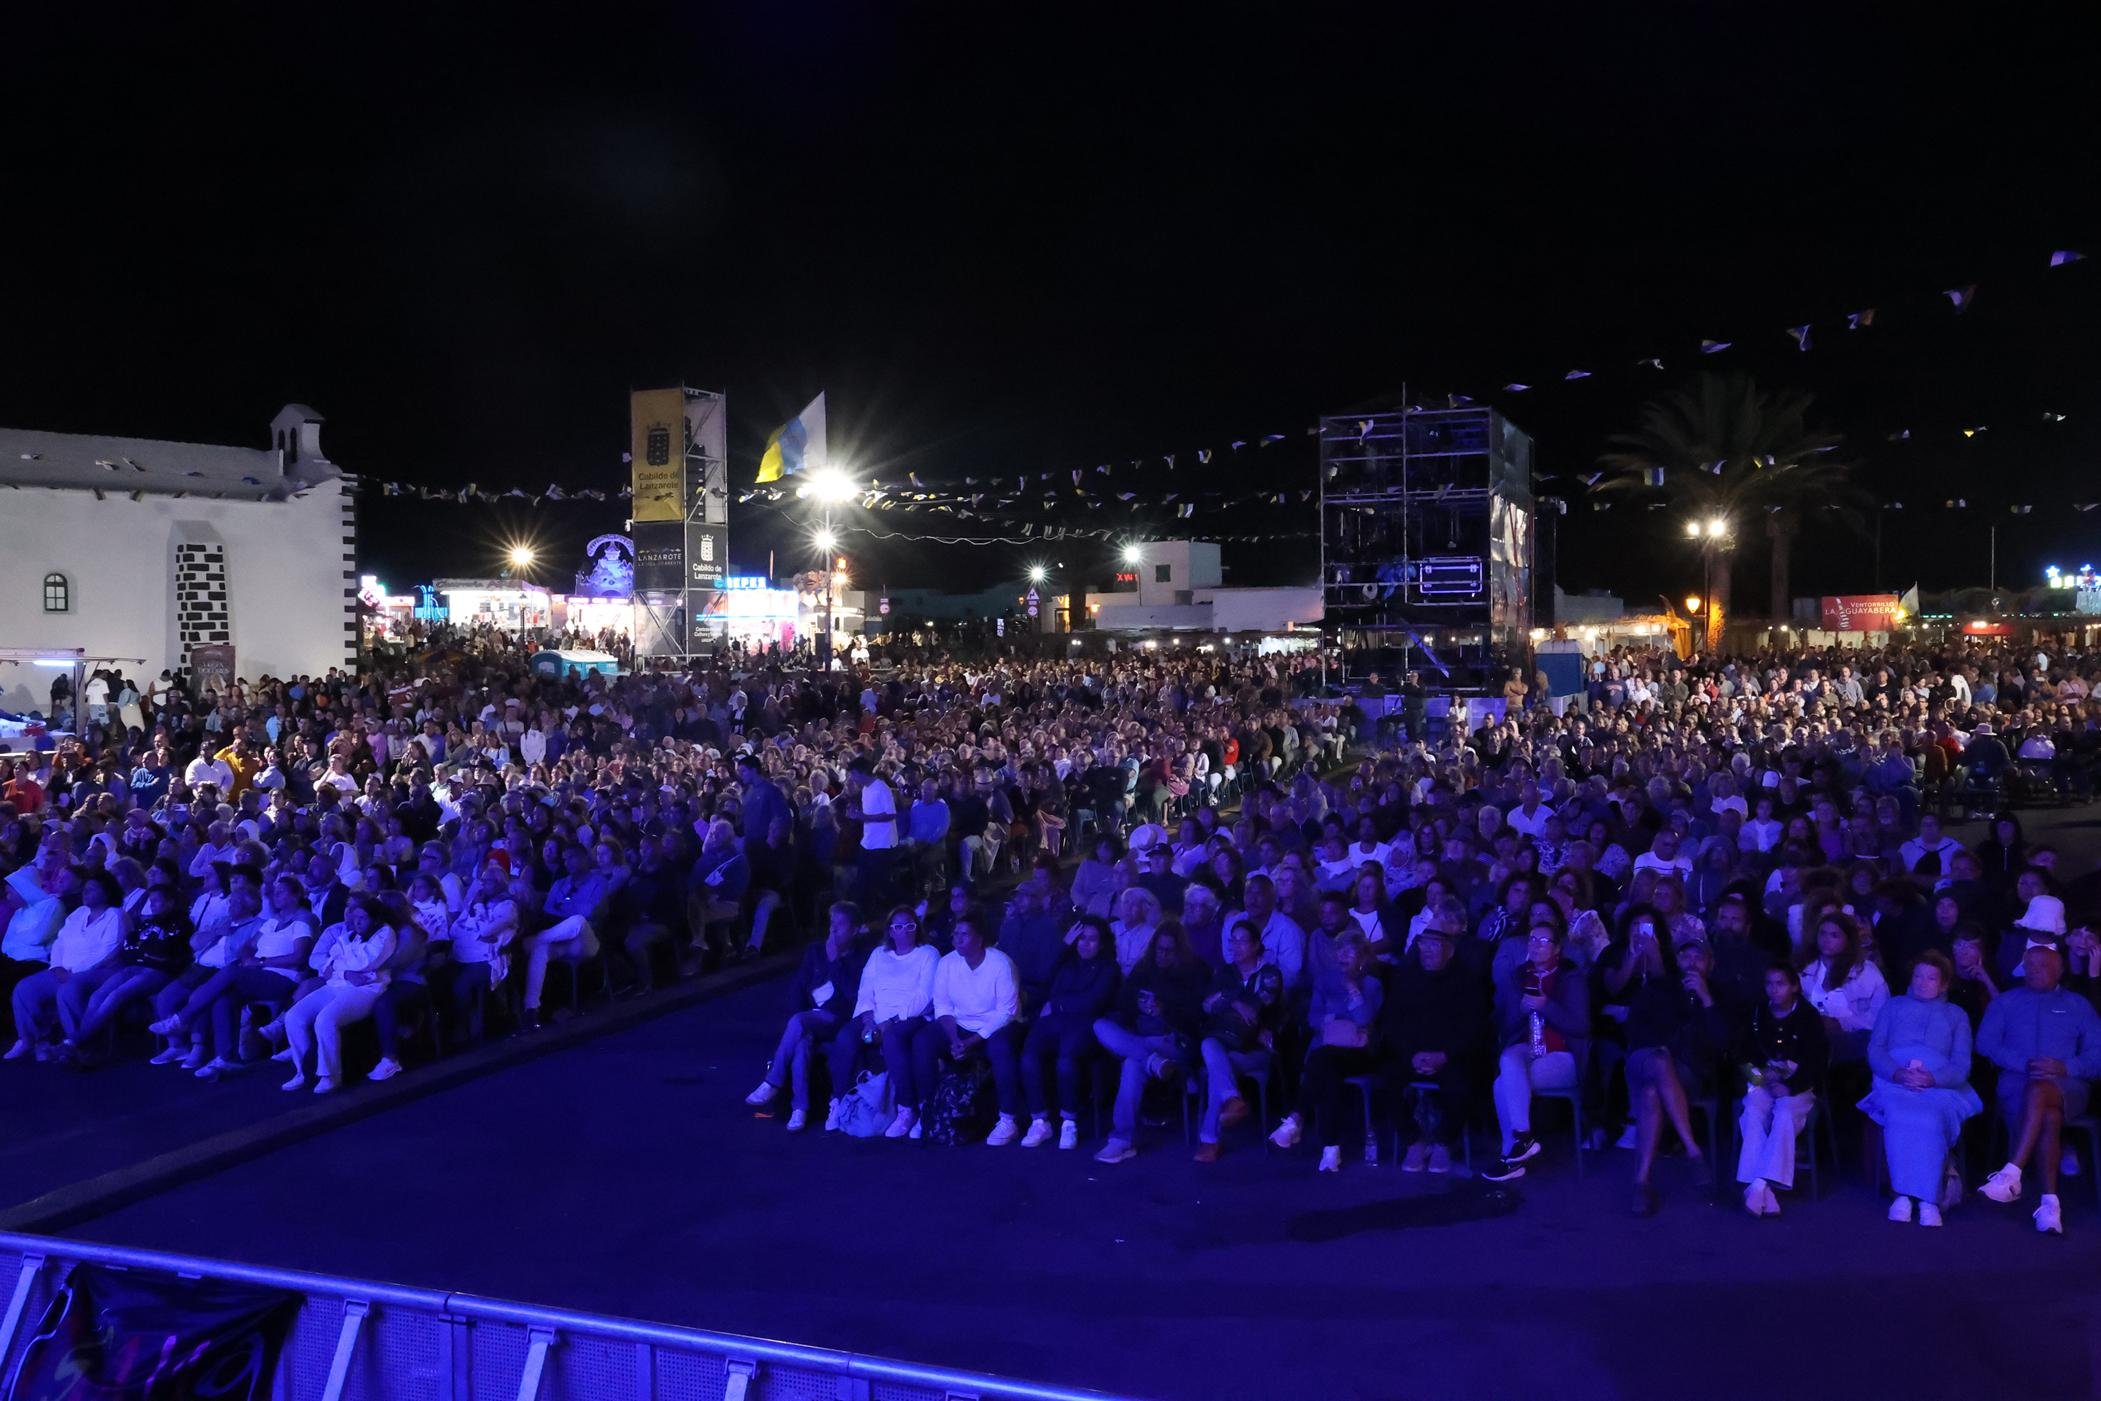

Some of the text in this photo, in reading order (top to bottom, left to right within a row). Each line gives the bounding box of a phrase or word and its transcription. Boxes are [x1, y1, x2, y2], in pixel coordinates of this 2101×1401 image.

[638, 471, 668, 480] Cabildo
[640, 481, 679, 489] Lanzarote
[637, 553, 682, 561] LANZAROTE
[692, 563, 722, 572] Cabildo de
[694, 571, 721, 580] Lanzarote
[1845, 607, 1897, 615] GUAYABERA
